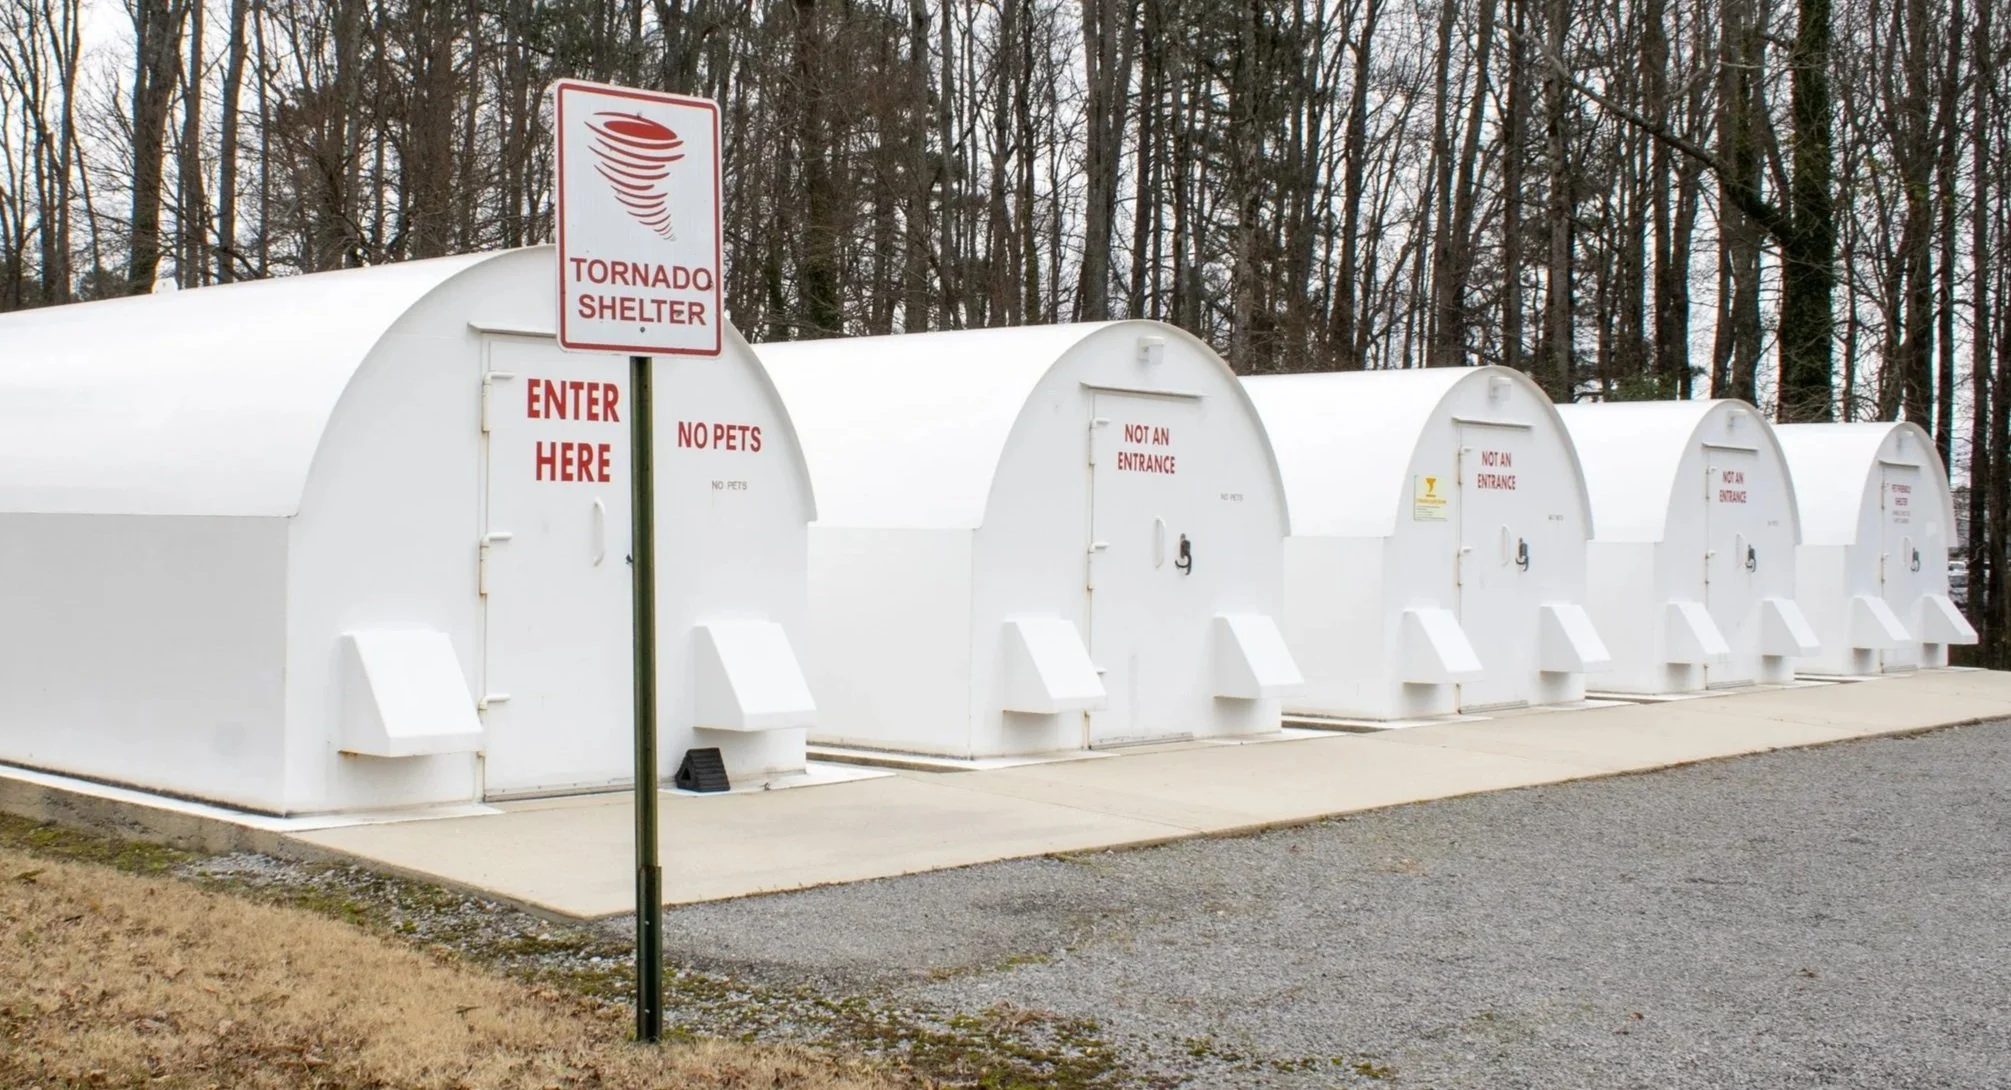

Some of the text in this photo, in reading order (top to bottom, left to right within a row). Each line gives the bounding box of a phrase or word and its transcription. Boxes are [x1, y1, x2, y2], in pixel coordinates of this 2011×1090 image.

[570, 257, 714, 291] TORNADO
[578, 294, 707, 326] SHELTER
[527, 378, 620, 423] ENTER
[677, 421, 762, 452] NO PETS
[1124, 423, 1169, 446] NOT AN
[535, 441, 611, 483] HERE
[1118, 451, 1176, 475] ENTRANCE
[1481, 450, 1512, 468] NOT AN
[711, 480, 748, 491] NO PETS
[1477, 473, 1516, 491] ENTRANCE
[1722, 470, 1744, 484] NOT AN
[1719, 489, 1747, 504] ENTRANCE
